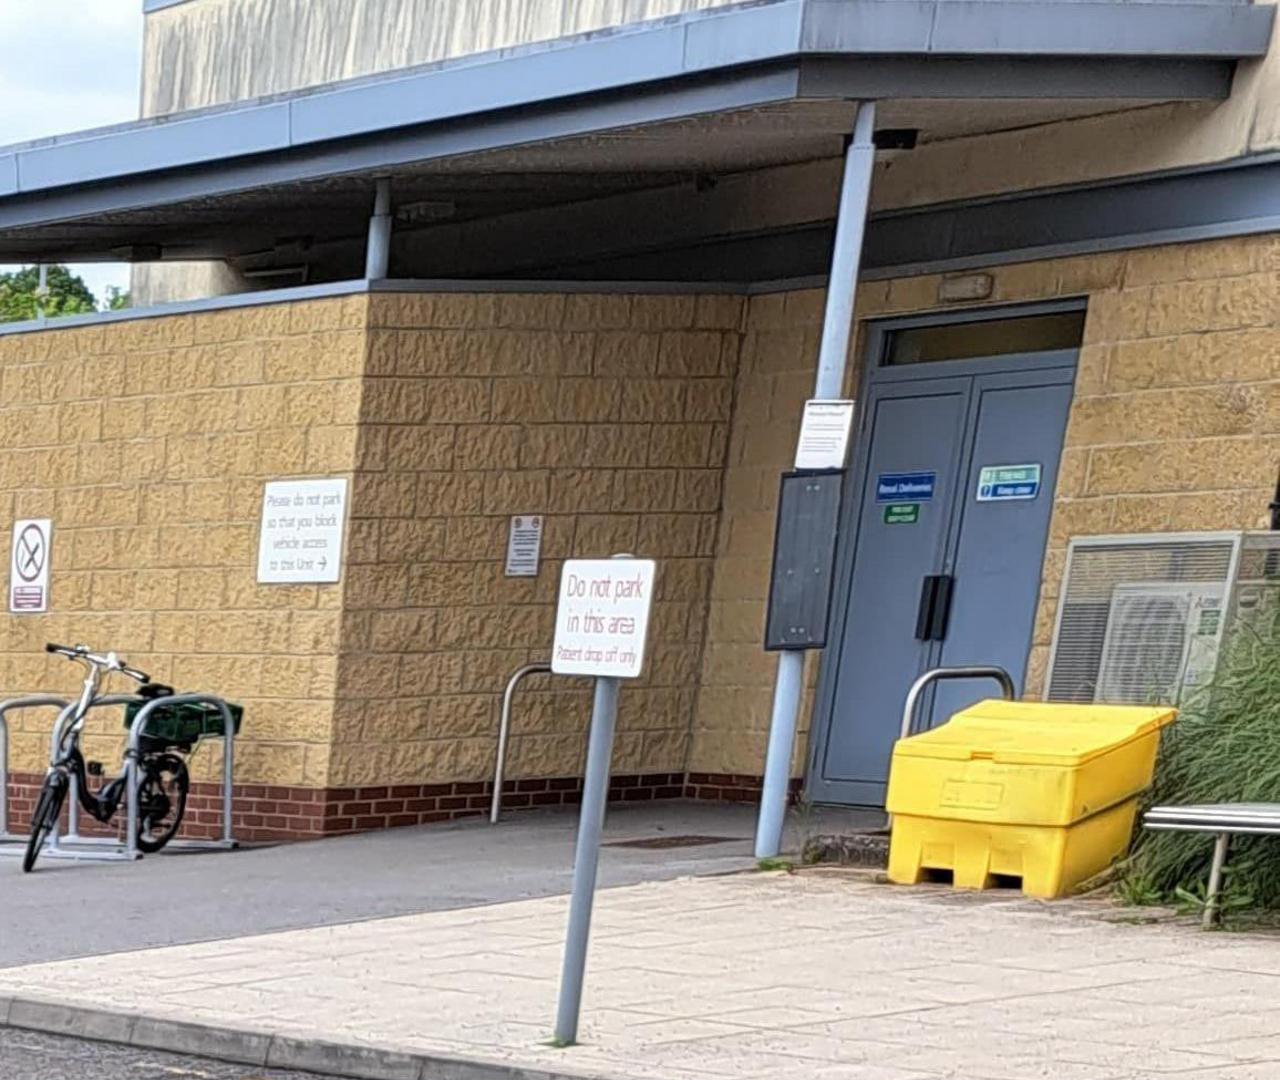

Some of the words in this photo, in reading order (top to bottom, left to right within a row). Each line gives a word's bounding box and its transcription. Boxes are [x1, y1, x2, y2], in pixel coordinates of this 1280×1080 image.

[267, 494, 290, 507] Please
[293, 491, 304, 506] do
[306, 493, 320, 505] not
[322, 491, 340, 509] park
[267, 518, 276, 528] so
[278, 516, 295, 528] that
[297, 517, 312, 531] you
[314, 513, 336, 527] block
[273, 536, 299, 549] vehicle
[302, 539, 328, 549] access
[567, 574, 586, 597] Do
[589, 576, 611, 598] not
[613, 573, 644, 604] park
[566, 608, 580, 633] in
[583, 608, 604, 633] this
[608, 617, 636, 635] area
[557, 645, 582, 661] Patient
[584, 646, 602, 665] drop
[604, 646, 619, 663] off
[619, 647, 637, 668] only
